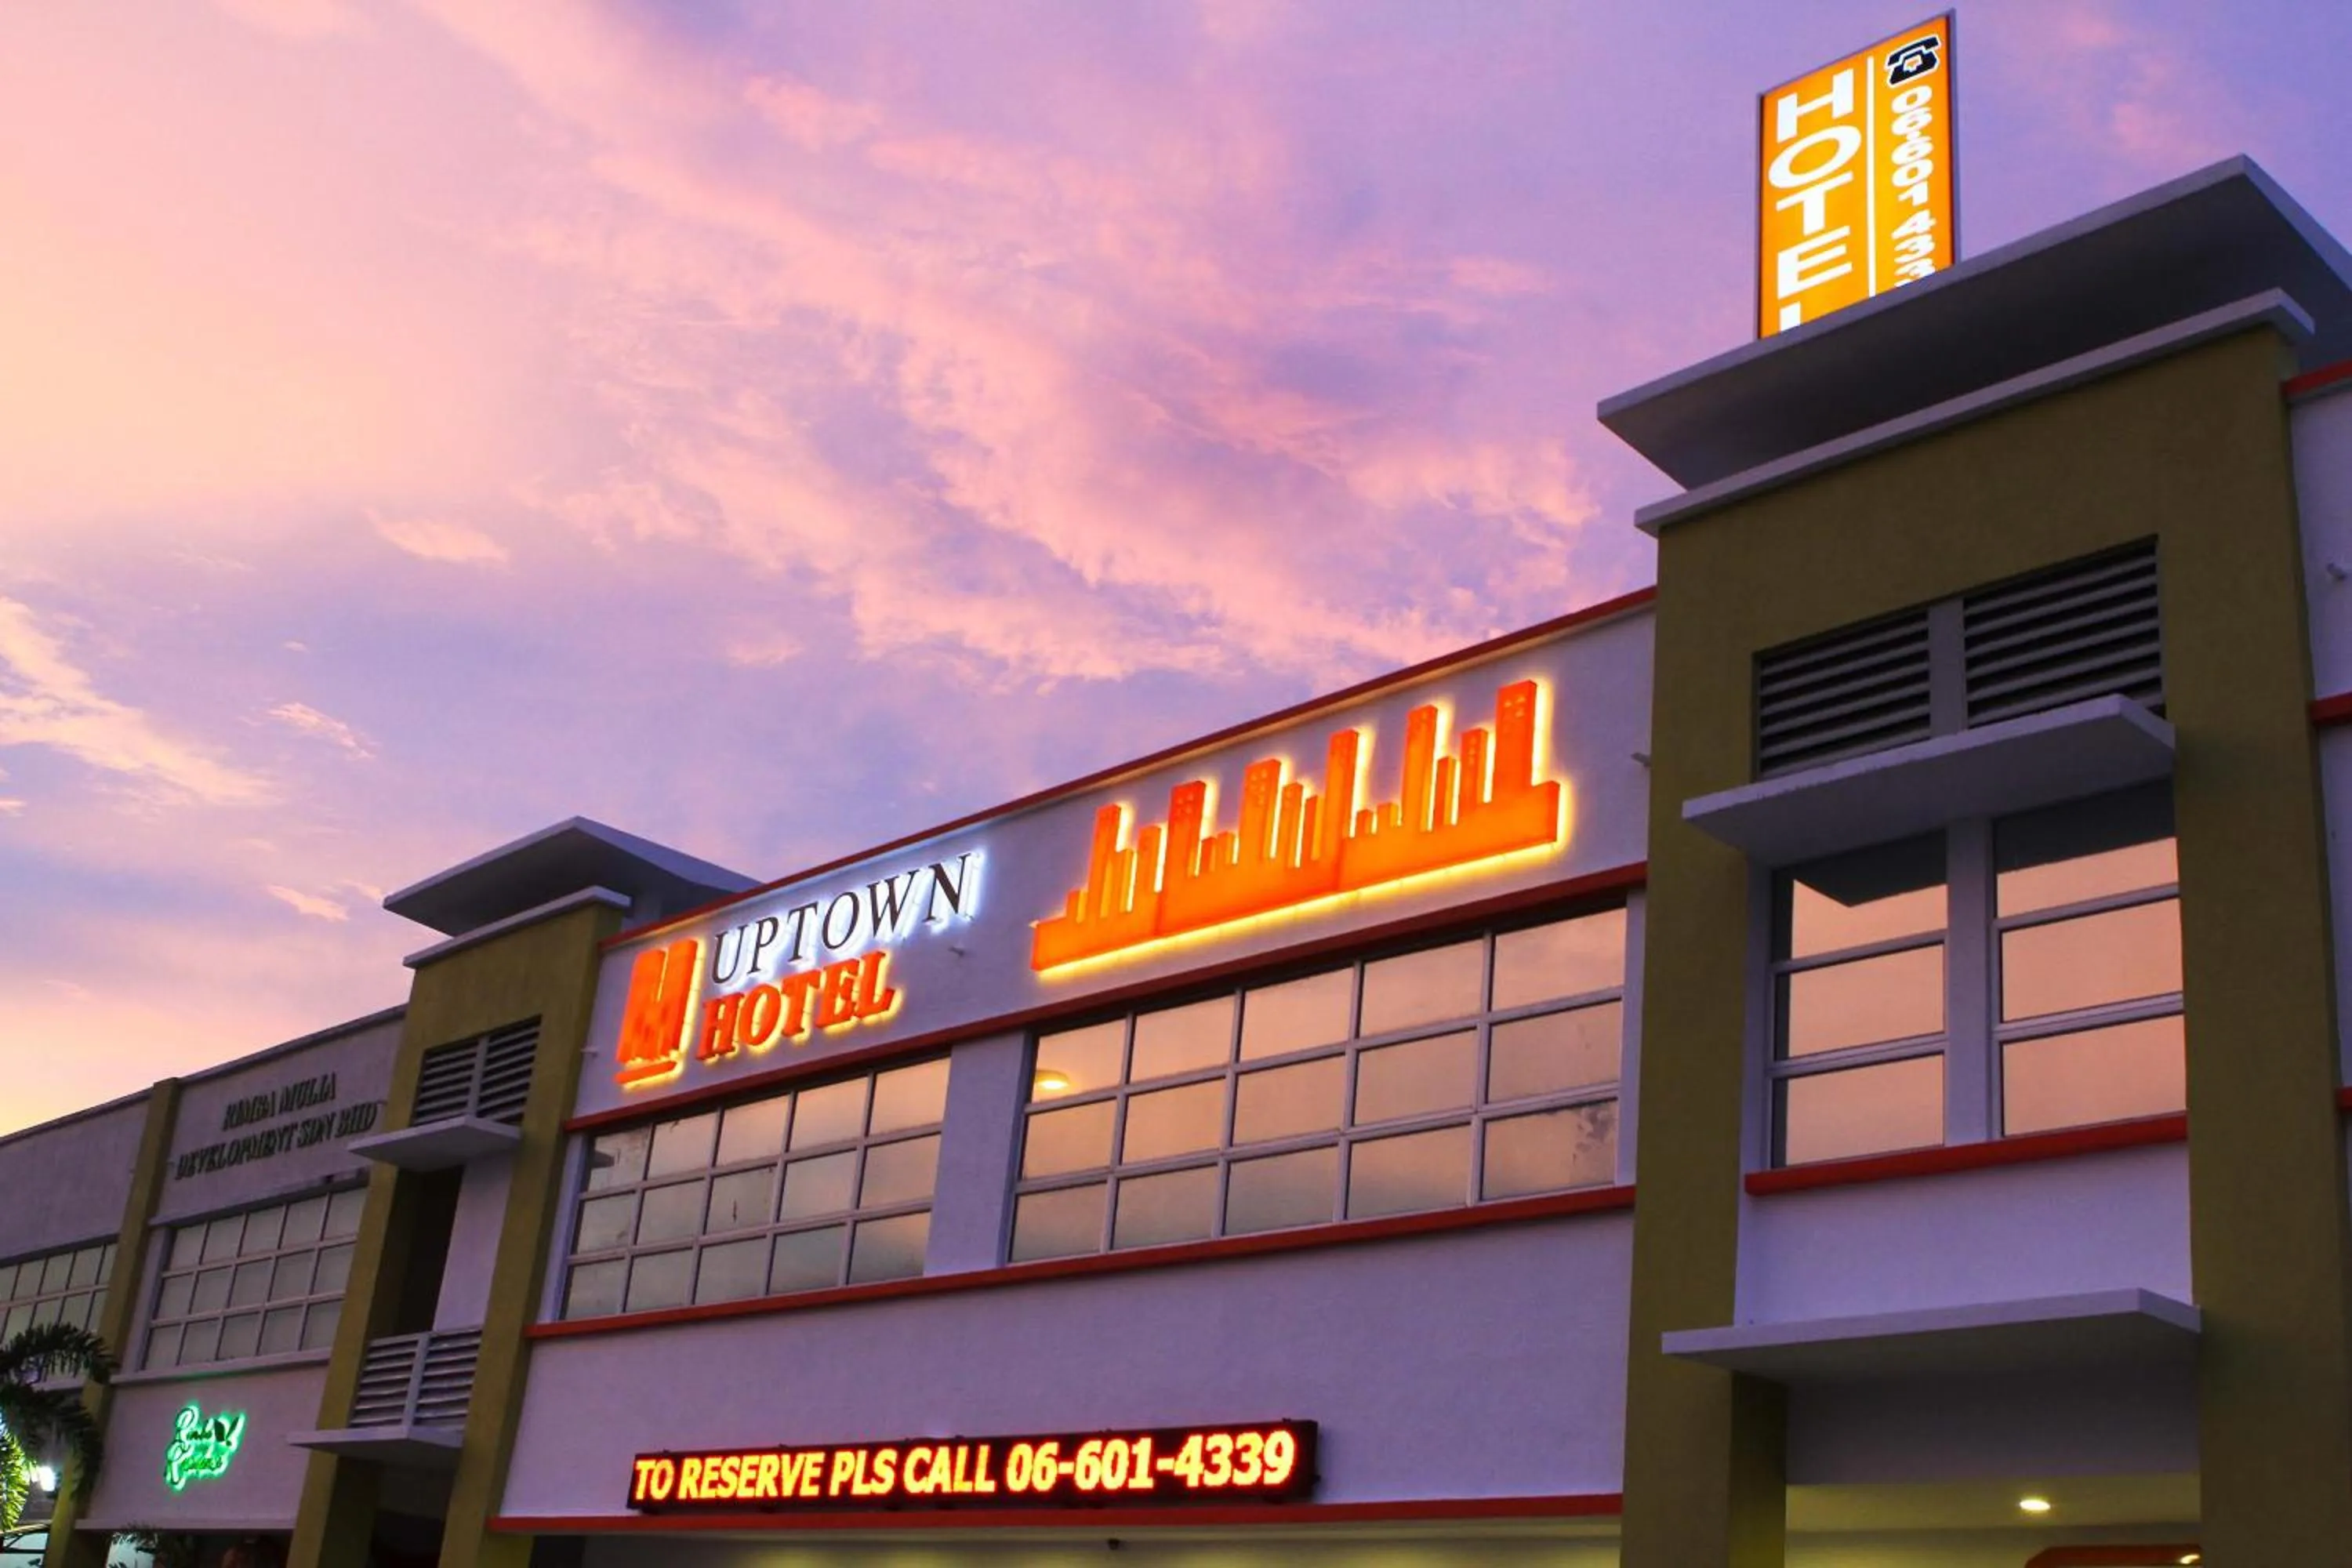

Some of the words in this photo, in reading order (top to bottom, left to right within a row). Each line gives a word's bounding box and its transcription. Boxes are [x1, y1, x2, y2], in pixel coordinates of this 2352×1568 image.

[711, 852, 973, 985] UPTOWN
[695, 950, 896, 1061] HOTEL
[635, 1458, 674, 1501] TO
[677, 1452, 825, 1499] RESERVE
[829, 1449, 898, 1496] PLS
[902, 1444, 996, 1494] CALL
[1006, 1430, 1296, 1493] 06-601-4339
